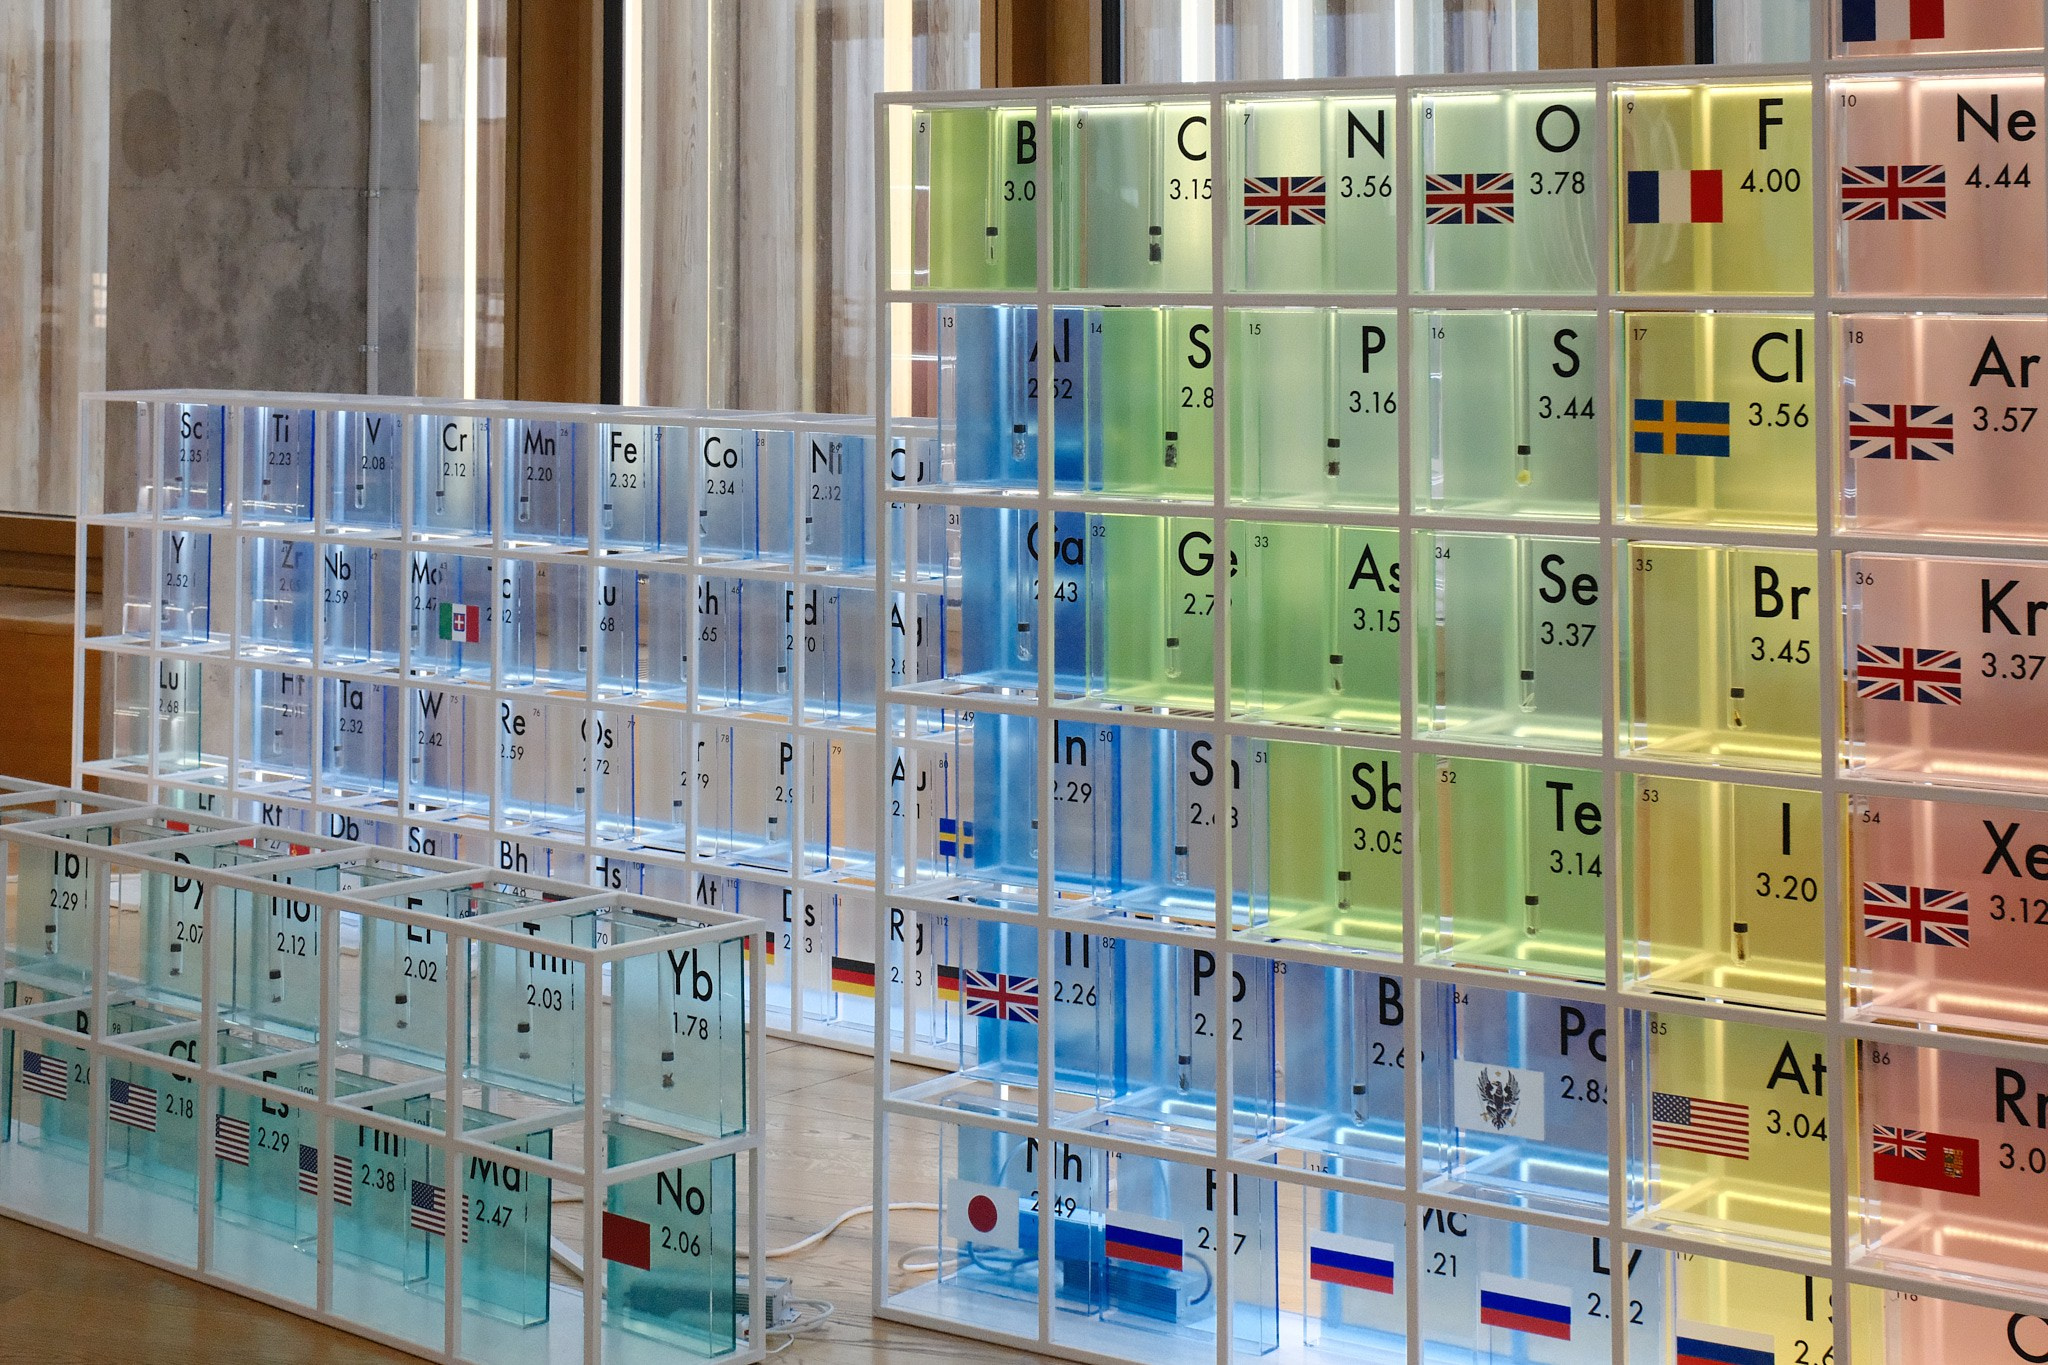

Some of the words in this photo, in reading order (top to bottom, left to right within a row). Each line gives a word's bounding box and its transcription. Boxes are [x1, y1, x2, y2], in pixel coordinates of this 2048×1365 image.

[1626, 101, 1635, 115] 9
[1841, 94, 1857, 107] 10
[1077, 118, 1084, 130] 6
[1243, 113, 1250, 126] 7
[1425, 107, 1432, 120] 8
[1759, 98, 1783, 150] F
[1957, 93, 2037, 143] Ne
[919, 122, 926, 133] 5
[1177, 116, 1207, 161] C
[1348, 108, 1385, 160] N
[1536, 104, 1580, 153] O
[1017, 120, 1037, 165] B
[1340, 175, 1392, 198] 3.56
[1530, 171, 1585, 195] 3.78
[1740, 168, 1800, 193] 4.00
[1964, 162, 2031, 189] 4.44
[1169, 179, 1213, 200] 3.15
[942, 317, 954, 329] 13
[1090, 323, 1103, 334] 14
[1249, 324, 1262, 336] 15
[1432, 328, 1445, 340] 16
[1633, 328, 1647, 342] 17
[1362, 325, 1386, 374] P
[1848, 331, 1864, 344] 18
[1552, 328, 1580, 378] S
[1751, 329, 1803, 383] Cl
[1968, 335, 2041, 388] Ar
[1349, 391, 1397, 414] 3.16
[1538, 396, 1595, 420] 3.44
[181, 412, 202, 439] Sc
[1748, 403, 1809, 428] 3.56
[1972, 406, 2038, 433] 3.57
[272, 414, 290, 443] Ti
[366, 418, 381, 444] V
[443, 423, 467, 452] Cr
[560, 428, 568, 436] 26
[524, 428, 556, 456] Mn
[611, 431, 637, 464] Fe
[704, 436, 738, 469] Co
[757, 438, 765, 446] 28
[180, 448, 202, 462] 2.35
[269, 452, 291, 466] 2.23
[362, 456, 385, 470] 2.08
[812, 439, 842, 475] Ni
[443, 462, 466, 477] 2.12
[526, 466, 552, 481] 2.20
[610, 473, 637, 489] 2.32
[707, 479, 734, 495] 2.34
[949, 514, 960, 525] 31
[1092, 526, 1106, 538] 32
[172, 535, 184, 563] Y
[281, 540, 303, 569] Zr
[1254, 536, 1269, 548] 33
[1435, 547, 1450, 560] 34
[325, 551, 351, 581] Nb
[1348, 543, 1400, 593] As
[1636, 559, 1653, 573] 35
[167, 573, 188, 588] 2.52
[1539, 554, 1598, 606] Se
[1855, 572, 1874, 586] 36
[325, 588, 349, 604] 2.59
[1754, 565, 1811, 620] Br
[1981, 579, 2048, 636] Kr
[1353, 608, 1400, 633] 3.15
[1541, 621, 1596, 647] 3.37
[1751, 637, 1810, 664] 3.45
[160, 661, 178, 690] Lu
[1981, 652, 2048, 681] 3.37
[159, 698, 179, 714] 2.68
[340, 680, 363, 710] Ta
[419, 690, 443, 720] W
[533, 708, 540, 717] 76
[962, 711, 975, 723] 49
[340, 718, 363, 734] 2.32
[418, 730, 442, 746] 2.42
[721, 734, 730, 743] 78
[1100, 731, 1113, 743] 50
[832, 746, 842, 755] 79
[1255, 752, 1268, 763] 51
[1350, 761, 1401, 813] Sb
[1441, 771, 1456, 784] 52
[1546, 781, 1602, 836] Te
[1642, 789, 1659, 803] 53
[331, 814, 359, 841] Db
[1782, 802, 1791, 855] I
[1862, 810, 1881, 824] 54
[1354, 828, 1402, 855] 3.05
[1982, 820, 2048, 880] Xe
[501, 840, 528, 873] Bh
[1550, 850, 1602, 878] 3.14
[1756, 872, 1818, 902] 3.20
[50, 889, 78, 911] 2.29
[1990, 895, 2048, 925] 3.12
[177, 921, 203, 944] 2.07
[277, 932, 305, 956] 2.12
[597, 932, 608, 945] 70
[1102, 938, 1116, 950] 82
[404, 956, 437, 982] 2.02
[667, 948, 713, 1002] Yb
[1273, 962, 1287, 974] 83
[24, 996, 33, 1006] 97
[527, 984, 562, 1011] 2.03
[1054, 981, 1097, 1007] 2.26
[1453, 991, 1469, 1006] 84
[112, 1023, 121, 1034] 98
[673, 1012, 708, 1041] 1.78
[1651, 1022, 1667, 1036] 85
[169, 1040, 197, 1083] Cf
[1766, 1040, 1827, 1096] At
[1872, 1051, 1890, 1066] 86
[166, 1093, 193, 1119] 2.18
[1766, 1110, 1828, 1142] 3.04
[258, 1126, 290, 1154] 2.29
[362, 1164, 395, 1192] 2.38
[470, 1146, 520, 1192] Md
[657, 1168, 705, 1216] No
[476, 1199, 512, 1228] 2.47
[661, 1226, 701, 1257] 2.06
